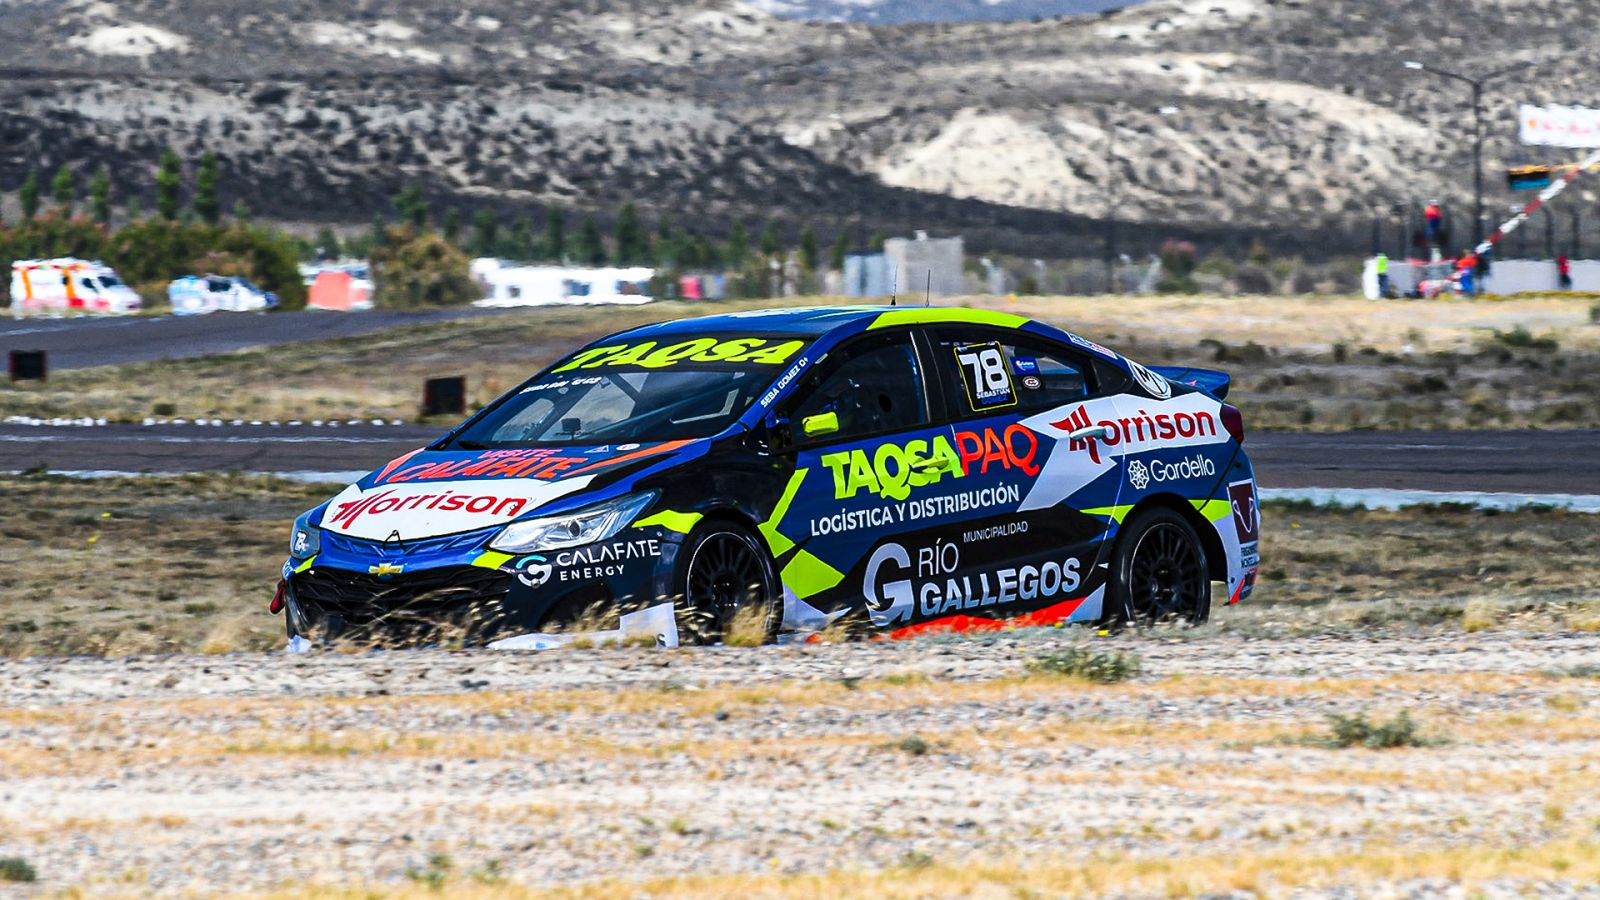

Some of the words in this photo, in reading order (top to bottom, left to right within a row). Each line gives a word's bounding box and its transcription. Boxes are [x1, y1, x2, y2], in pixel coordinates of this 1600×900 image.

[551, 338, 804, 373] TAQSA
[958, 348, 1009, 393] 78
[760, 387, 780, 408] SEBA
[777, 364, 801, 389] GOMEZ
[387, 457, 589, 483] CALAFATE
[810, 505, 894, 537] LOGÍSTICA
[896, 503, 906, 522] Y
[908, 482, 1021, 521] DISTRIBUCIÓN
[962, 520, 1029, 543] MUNICIPALIDAD
[556, 539, 662, 567] CALAFATE
[918, 538, 959, 578] RÍO
[560, 564, 625, 581] ENERGY
[919, 557, 1081, 616] GALLEGOS
